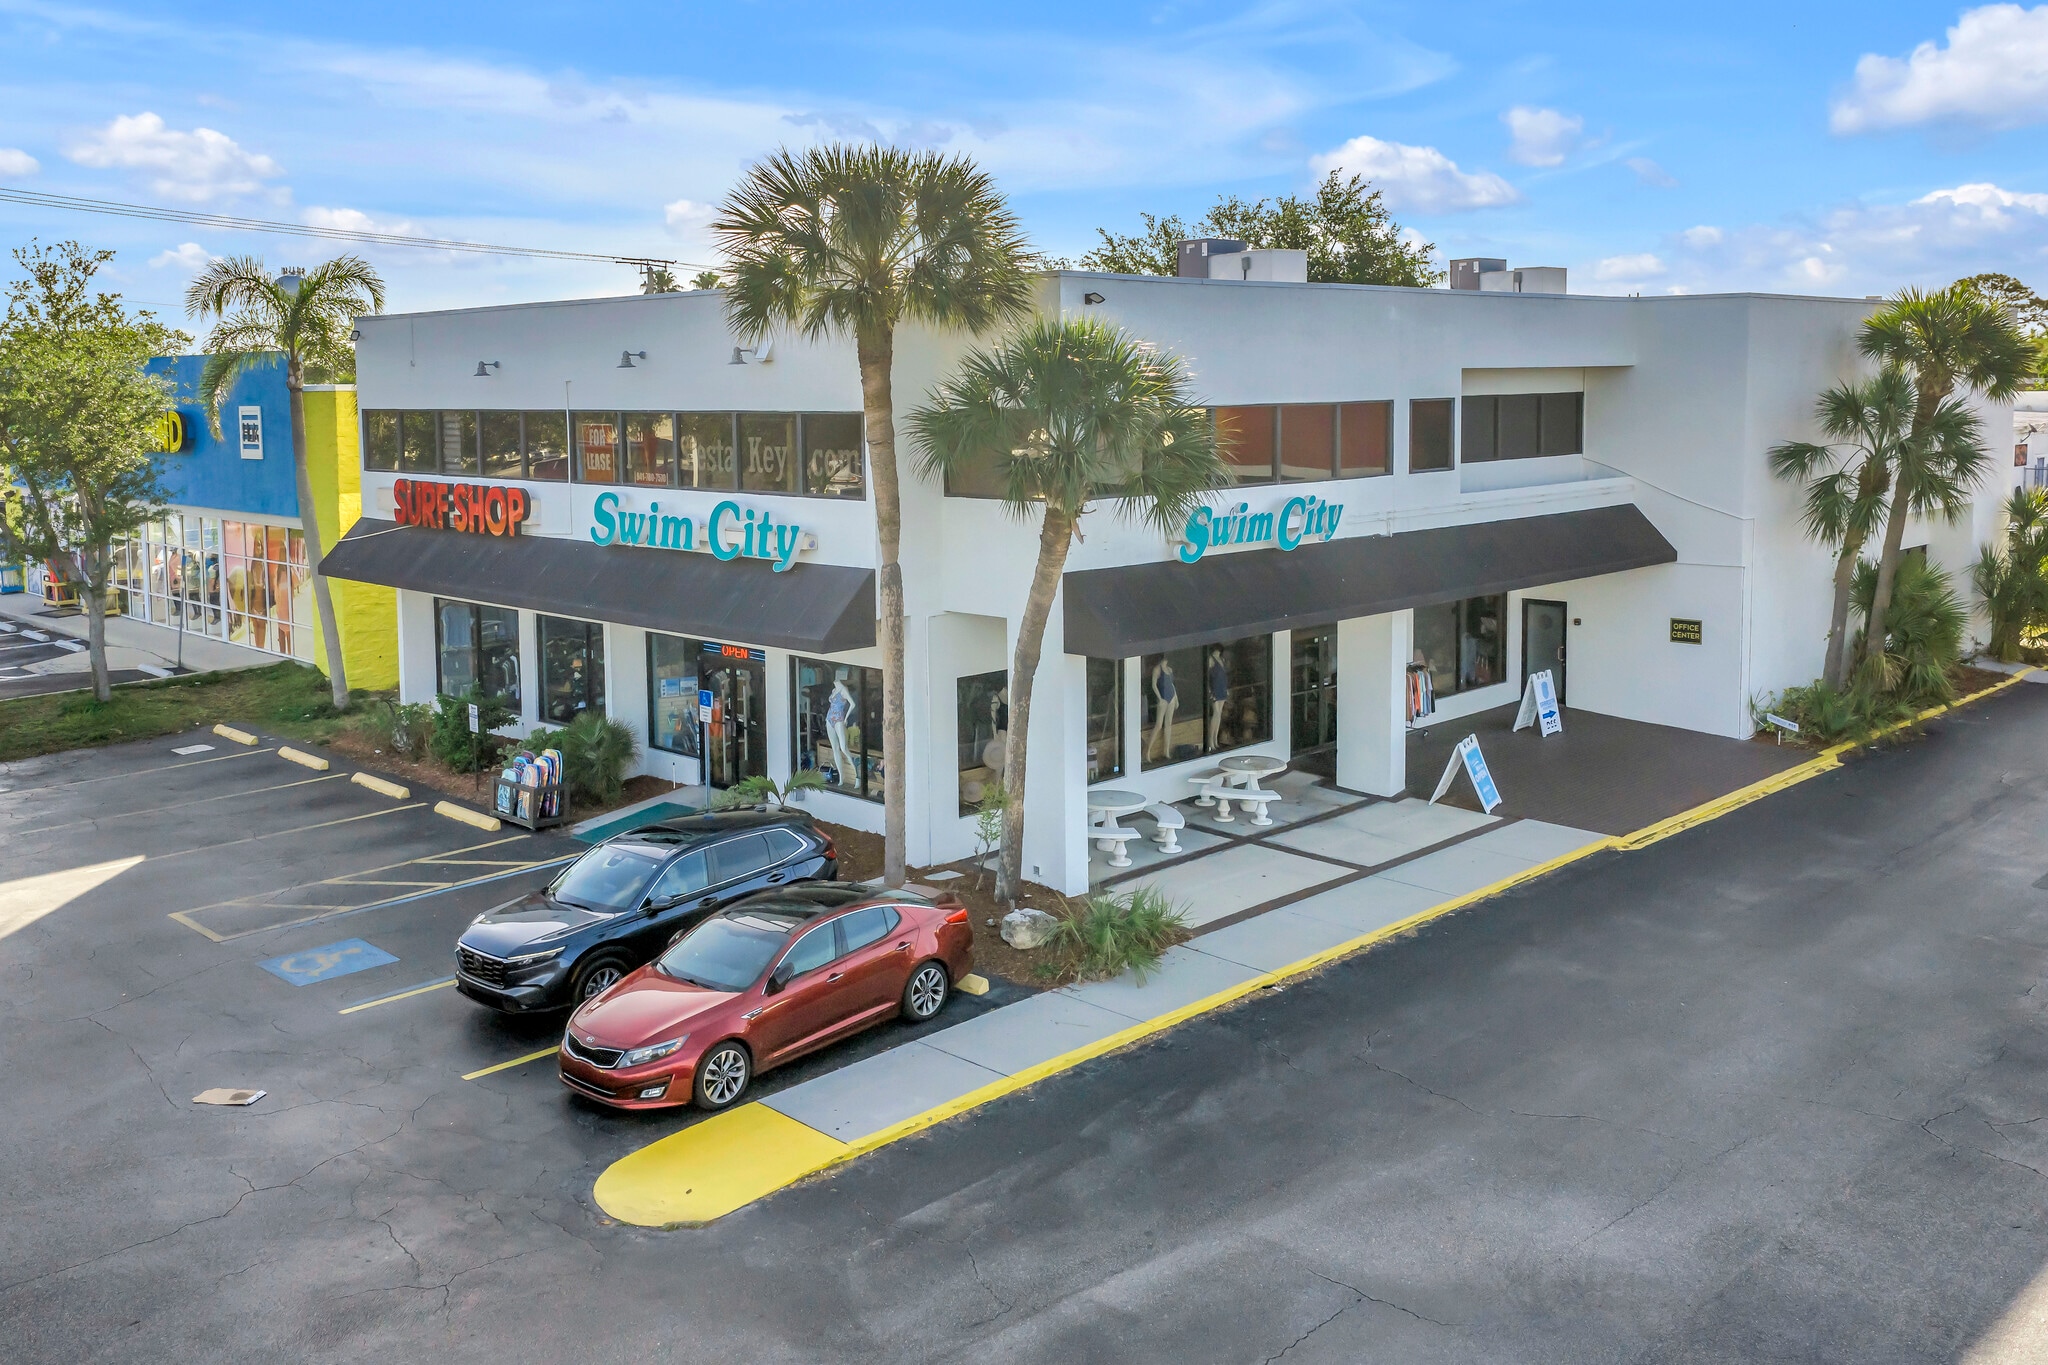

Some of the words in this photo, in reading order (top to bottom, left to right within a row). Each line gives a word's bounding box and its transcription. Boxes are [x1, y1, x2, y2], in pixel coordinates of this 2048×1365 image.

[588, 428, 606, 446] FOR
[586, 453, 611, 470] LEASE
[747, 436, 788, 482] Key
[394, 478, 449, 530] SURF
[453, 483, 525, 537] SHOP
[590, 491, 694, 547] Swim
[708, 500, 800, 573] City
[1179, 505, 1275, 564] Swim
[1277, 494, 1344, 552] City
[1672, 630, 1700, 640] CENTER
[1673, 622, 1699, 632] OFFICE
[721, 645, 748, 659] OPEN
